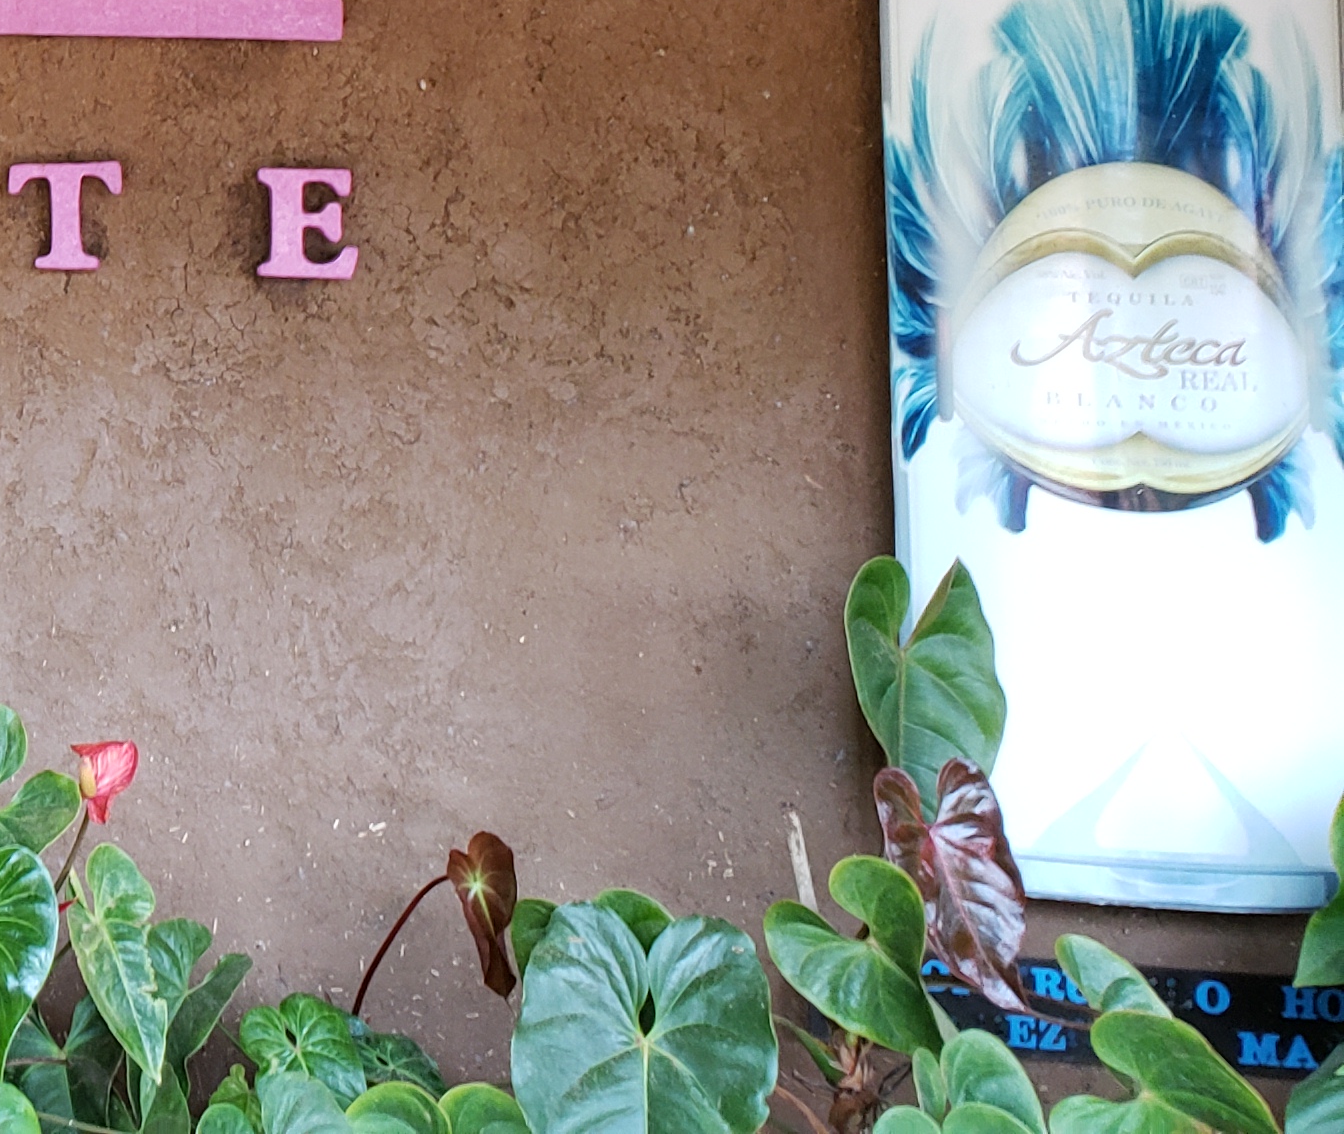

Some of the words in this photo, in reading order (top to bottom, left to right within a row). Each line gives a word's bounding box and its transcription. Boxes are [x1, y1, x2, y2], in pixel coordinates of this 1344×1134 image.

[1085, 196, 1136, 211] PURO
[1141, 197, 1167, 210] DE
[1067, 291, 1194, 307] TEQUILA
[1010, 308, 1248, 379] Azteca
[1179, 369, 1258, 392] REAL
[1046, 391, 1218, 413] BLANCO
